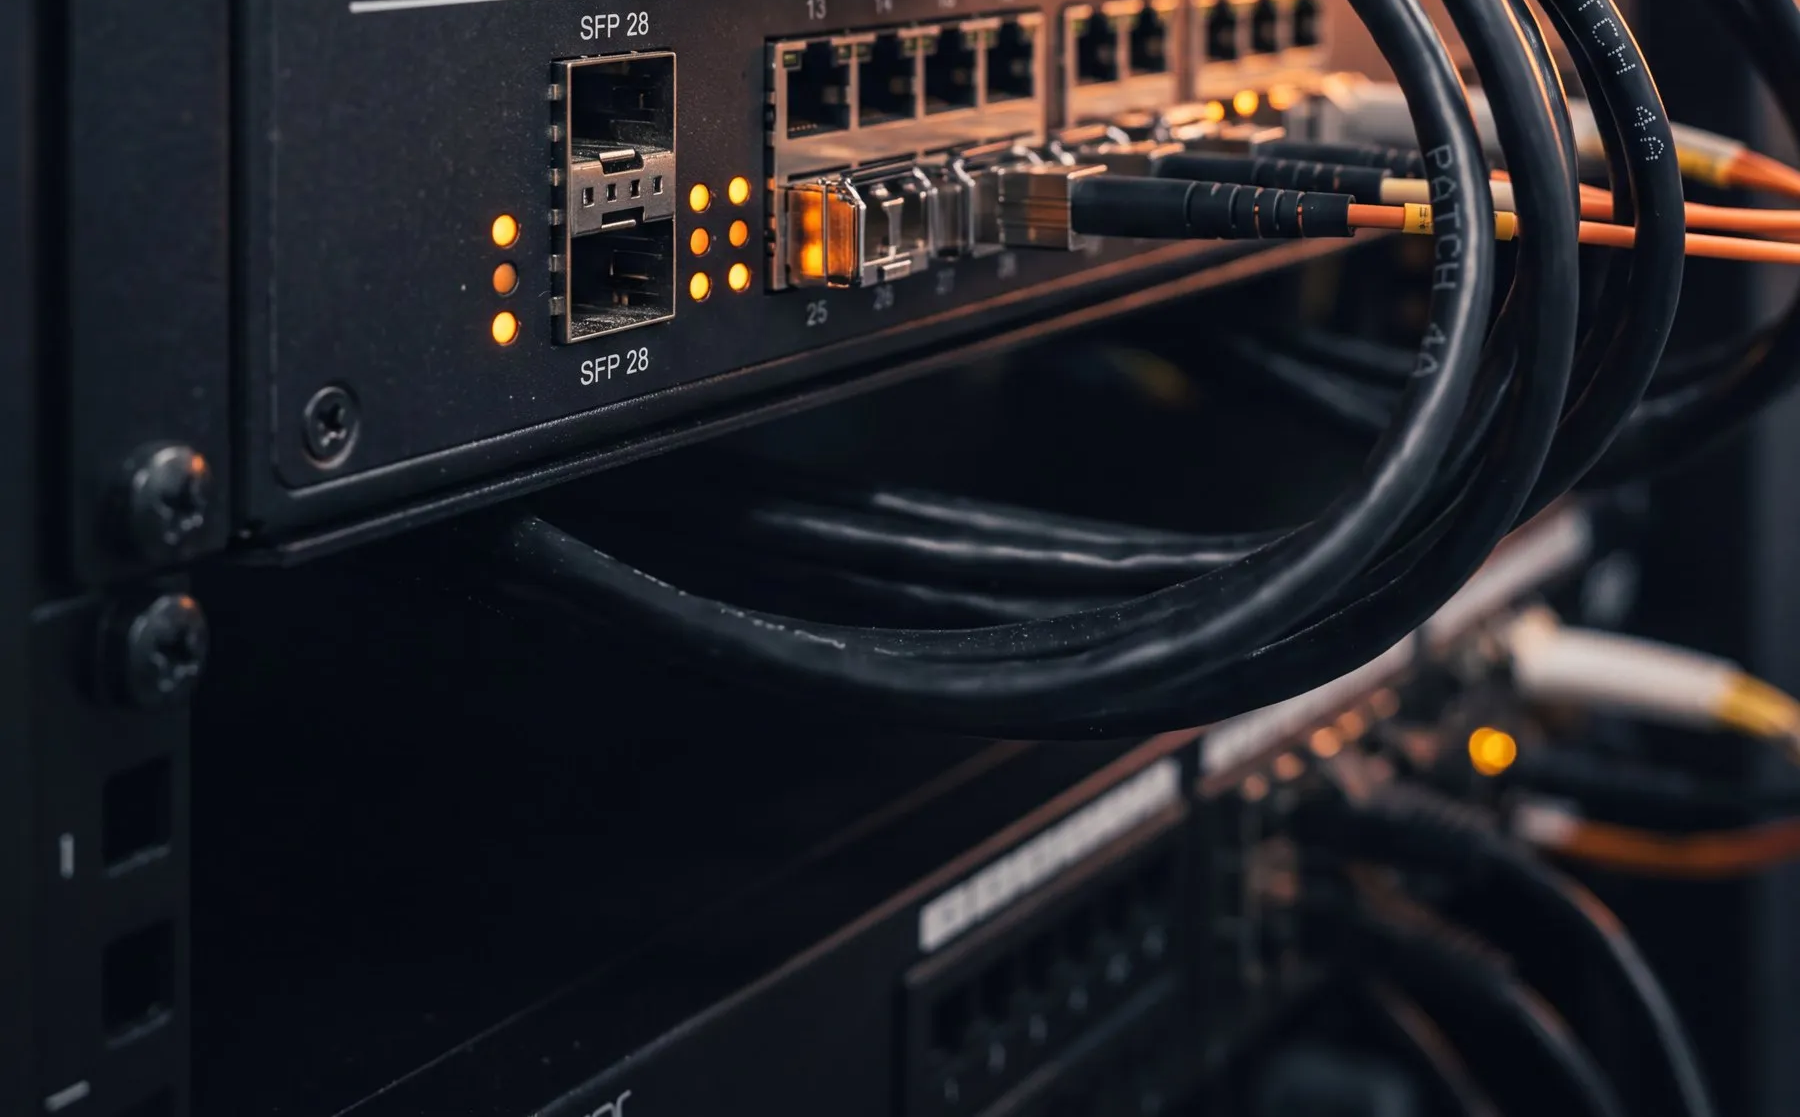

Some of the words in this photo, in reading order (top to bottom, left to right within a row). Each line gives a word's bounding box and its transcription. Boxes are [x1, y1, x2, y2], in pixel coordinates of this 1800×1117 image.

[580, 13, 620, 40] SFP
[626, 11, 649, 36] 28
[1426, 144, 1462, 290] PATCH
[806, 299, 828, 326] 25
[580, 353, 620, 386] SFP
[626, 346, 649, 374] 28
